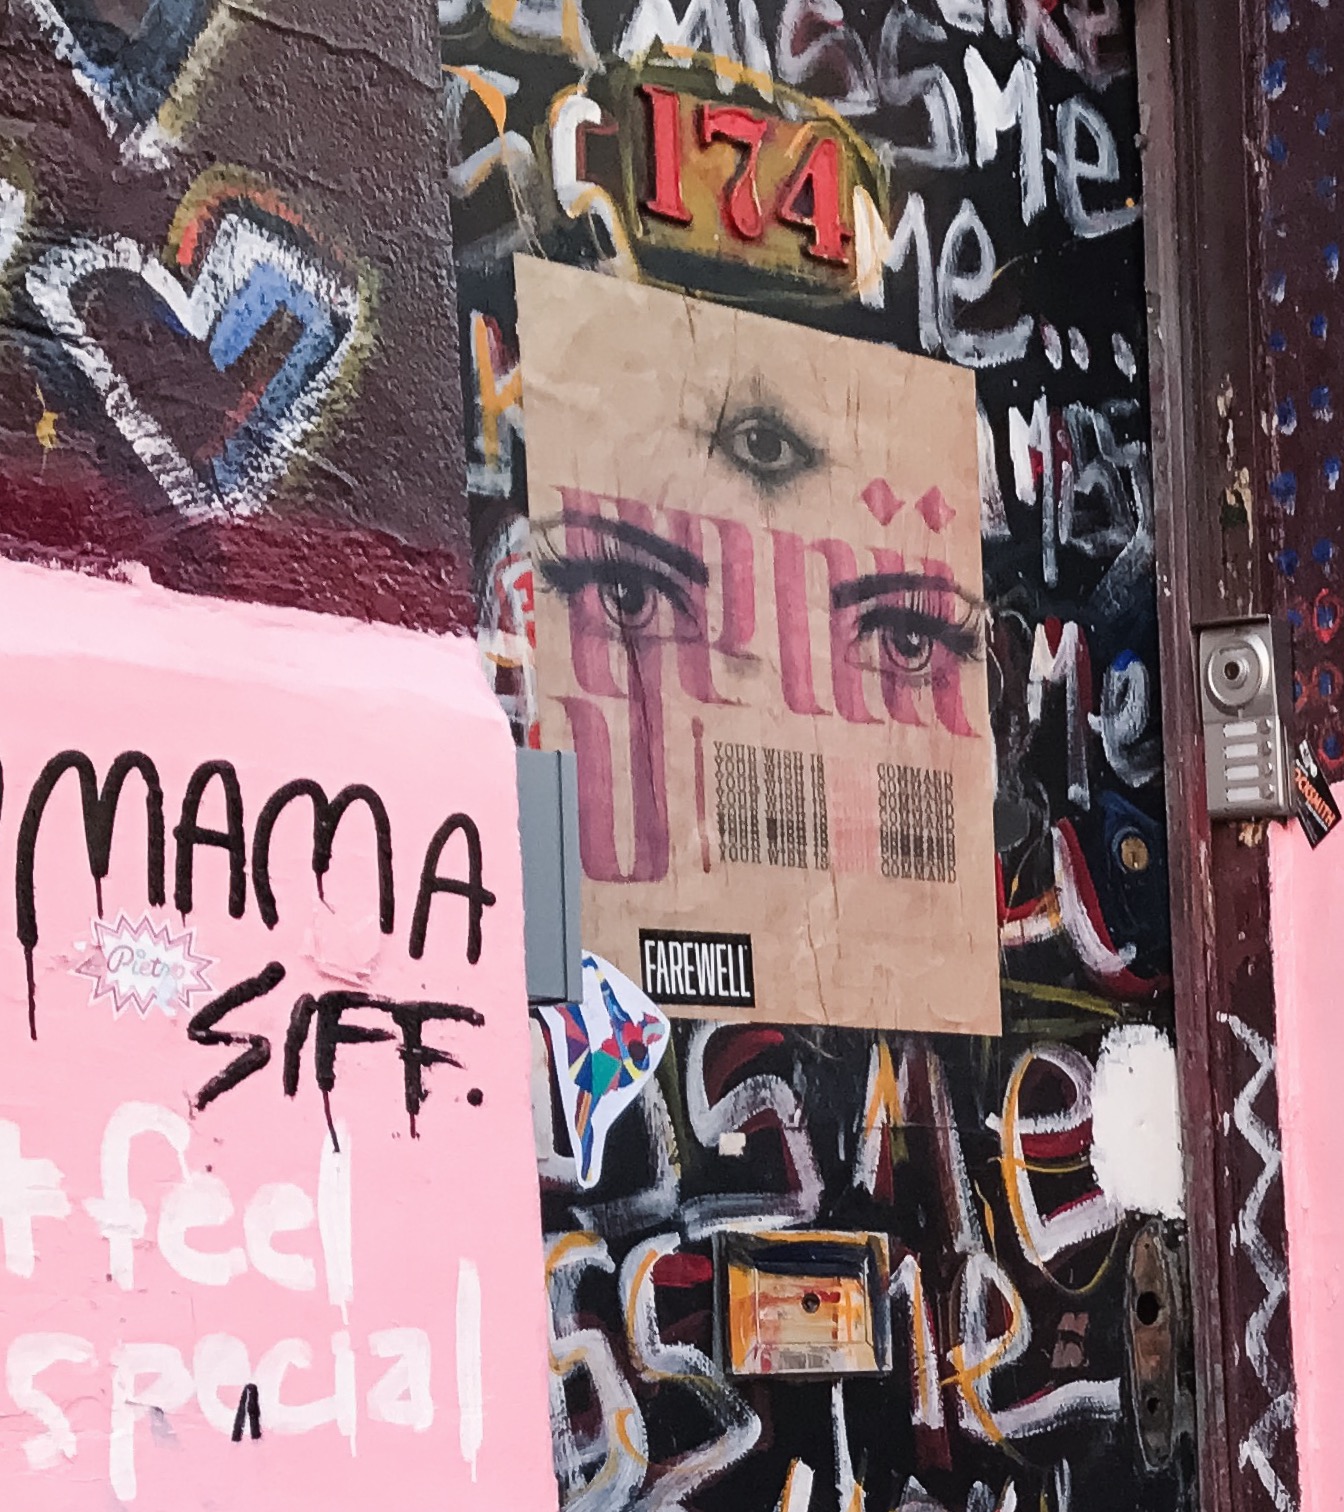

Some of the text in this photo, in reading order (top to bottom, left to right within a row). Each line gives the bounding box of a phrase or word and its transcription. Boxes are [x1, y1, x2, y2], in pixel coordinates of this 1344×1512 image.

[640, 82, 853, 266] 174
[16, 750, 496, 965] MAMA
[644, 940, 751, 998] FAREWELL
[82, 1101, 353, 1306] feel
[6, 1257, 484, 1501] special
